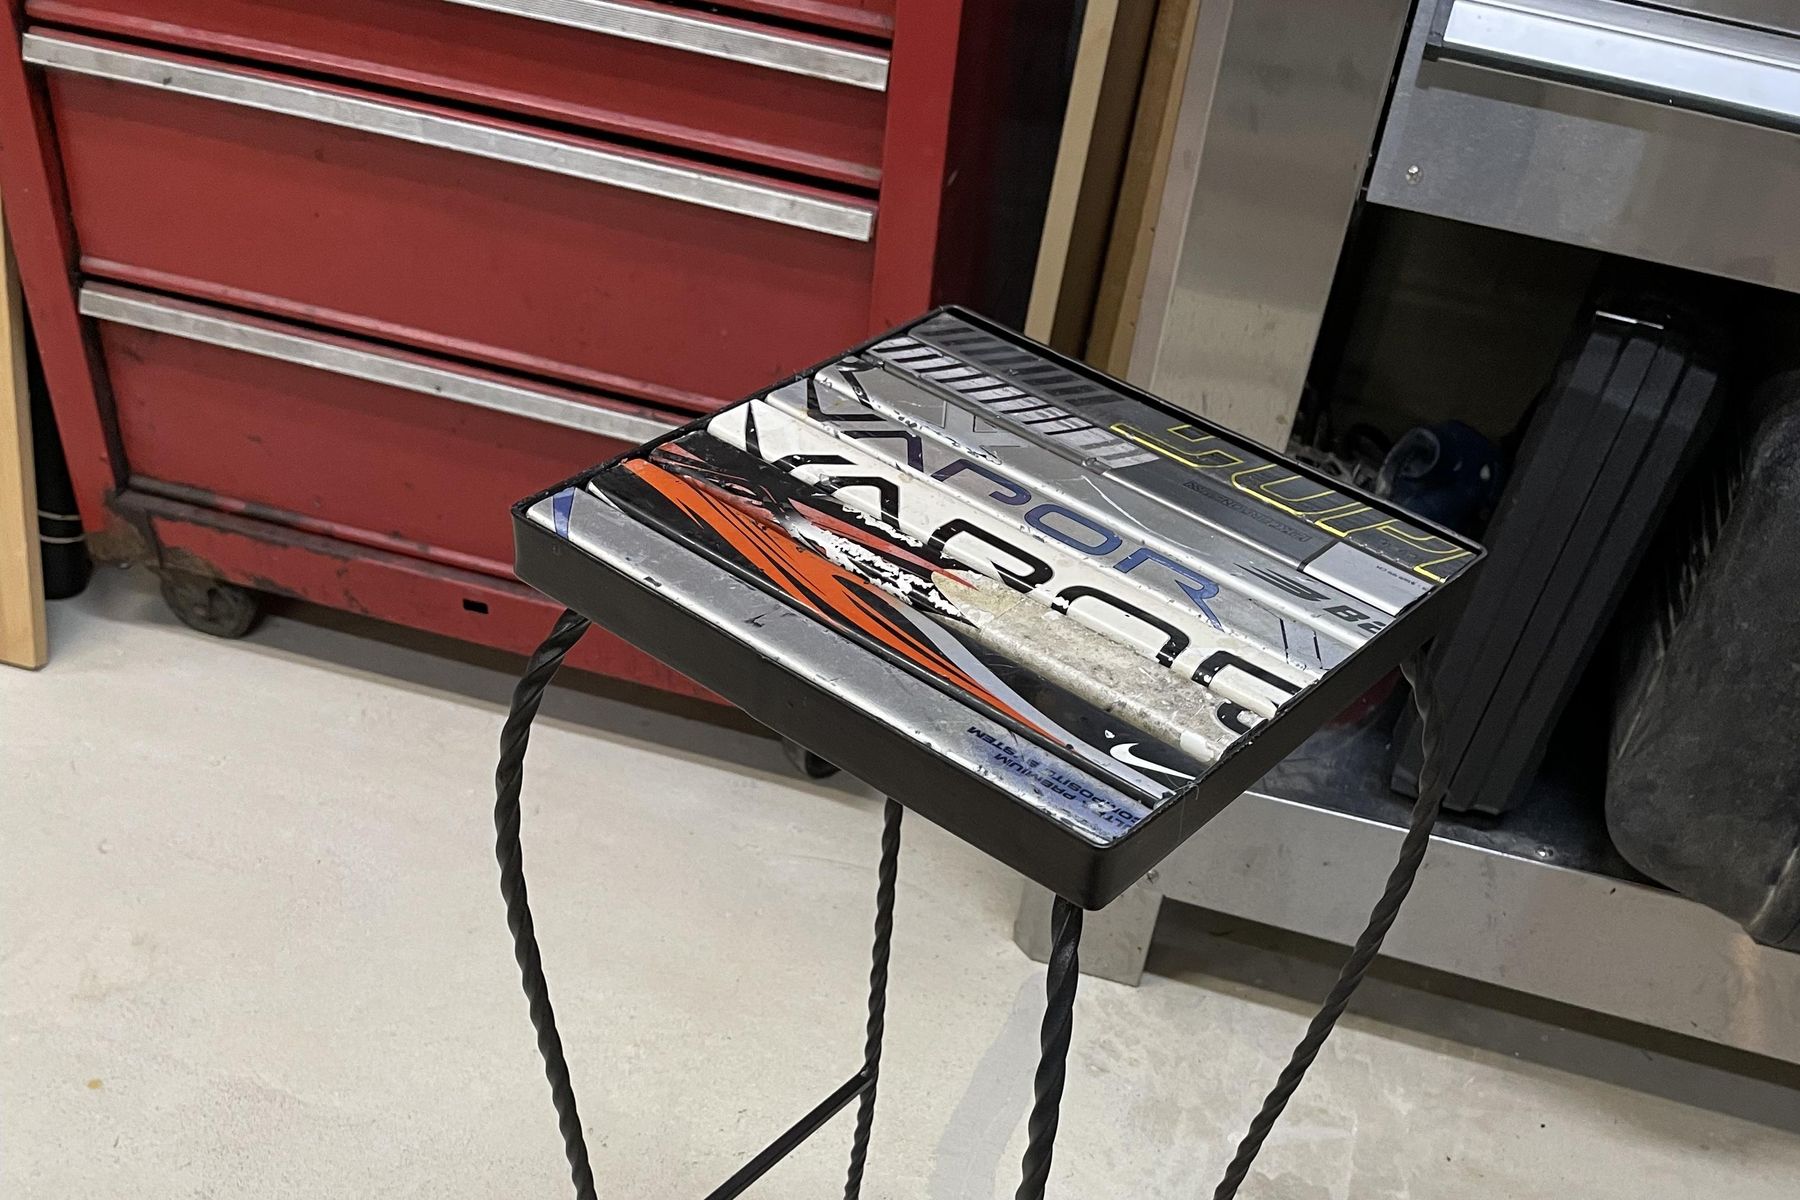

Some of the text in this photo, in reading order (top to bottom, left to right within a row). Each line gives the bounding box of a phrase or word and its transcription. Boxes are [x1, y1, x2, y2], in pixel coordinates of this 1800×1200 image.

[806, 376, 1224, 632] VAPOR
[1110, 423, 1473, 583] SUP
[993, 752, 1076, 801] PREMIUM
